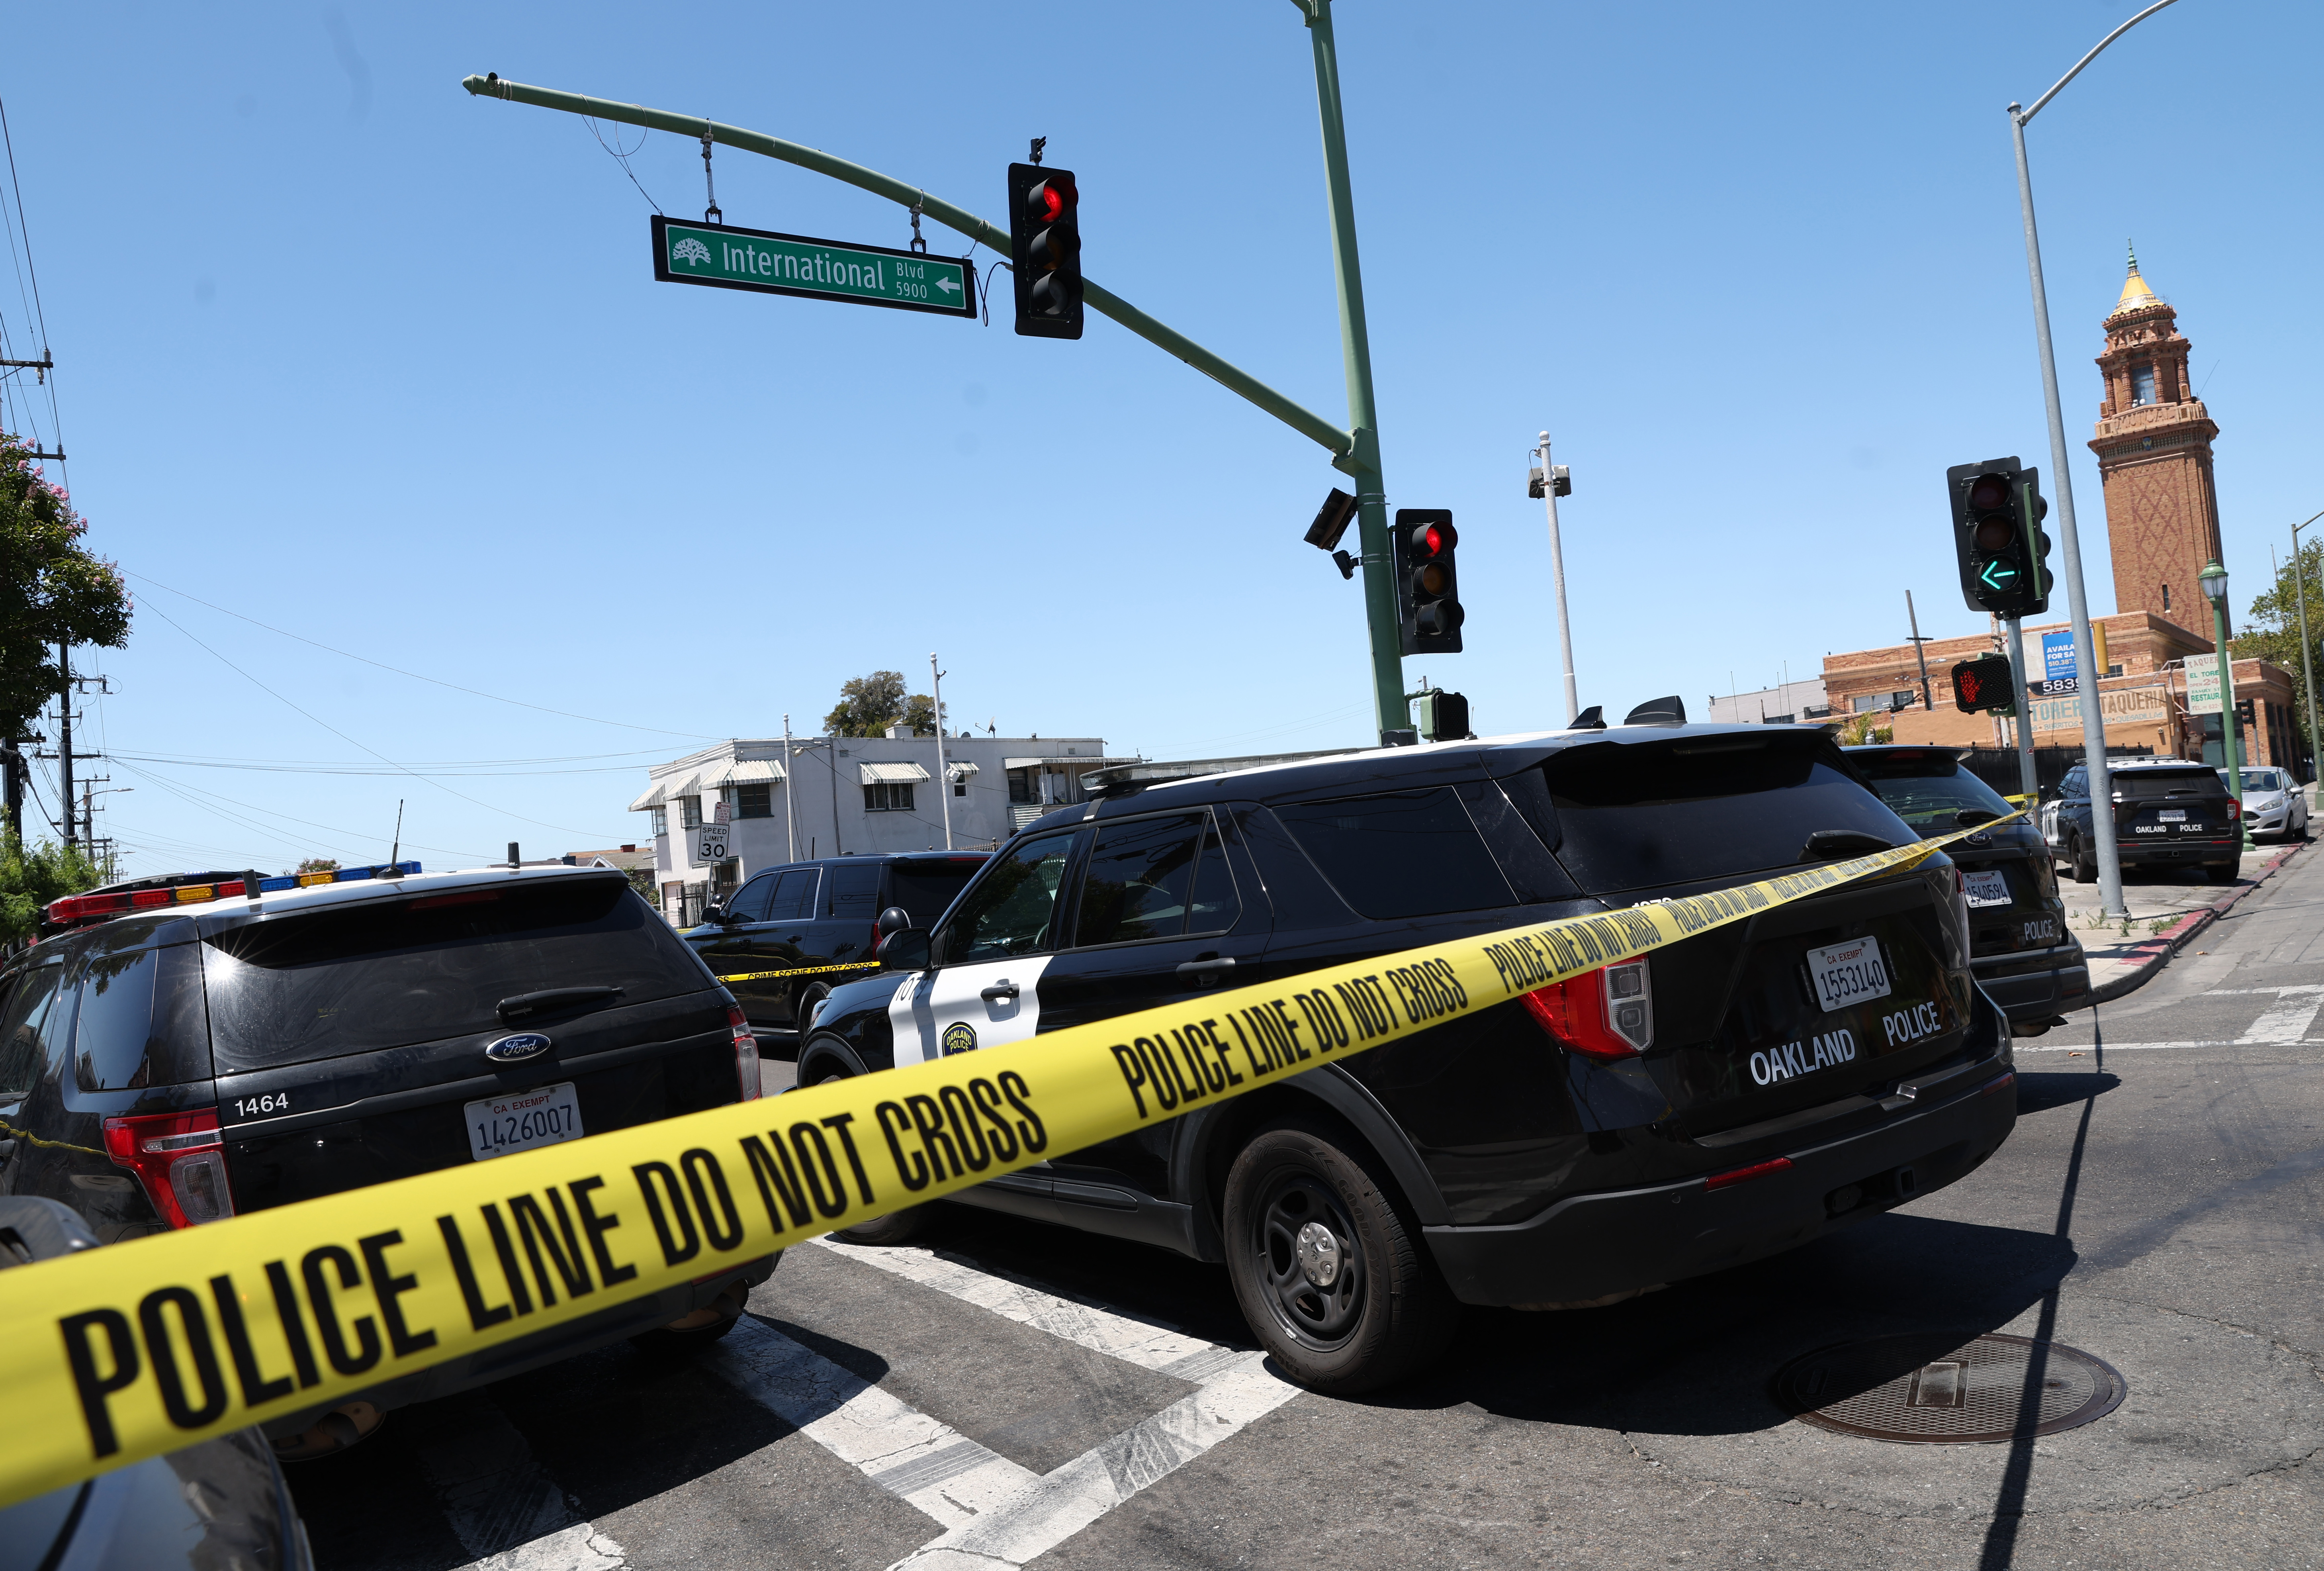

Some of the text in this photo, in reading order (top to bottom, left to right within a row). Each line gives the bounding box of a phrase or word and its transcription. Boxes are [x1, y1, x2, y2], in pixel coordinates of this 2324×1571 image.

[723, 242, 885, 290] International
[896, 262, 924, 279] Blvd
[896, 281, 927, 298] 5900
[2047, 644, 2075, 653] AVAILA
[2203, 678, 2219, 686] 24
[2099, 690, 2167, 714] TAQUERIA
[2043, 721, 2079, 730] BURRITOS
[2116, 712, 2163, 723] QUESADILLAS
[1972, 832, 1986, 841] Ford
[701, 843, 725, 858] 30
[1967, 883, 2007, 903] 1540594
[2025, 919, 2053, 940] POLICE
[1482, 909, 1662, 994] POLICE LINE DO NOT CROSS
[1827, 948, 1863, 965] CA EXEMPT
[1820, 959, 1885, 1001] 1553140
[1882, 1001, 1941, 1046] POLICE
[503, 1038, 537, 1056] Ford
[947, 1030, 971, 1046] OAKLAND
[950, 1039, 969, 1053] POLICE
[1109, 958, 1468, 1119] POLICE LINE DO NOT CROSS
[1750, 1029, 1855, 1086] OAKLAND
[235, 1093, 288, 1117] 1464
[494, 1095, 550, 1114] CA EXEMPT
[478, 1104, 571, 1151] 1426007
[59, 1070, 1047, 1459] POLICE LINE DO NOT CROSS
